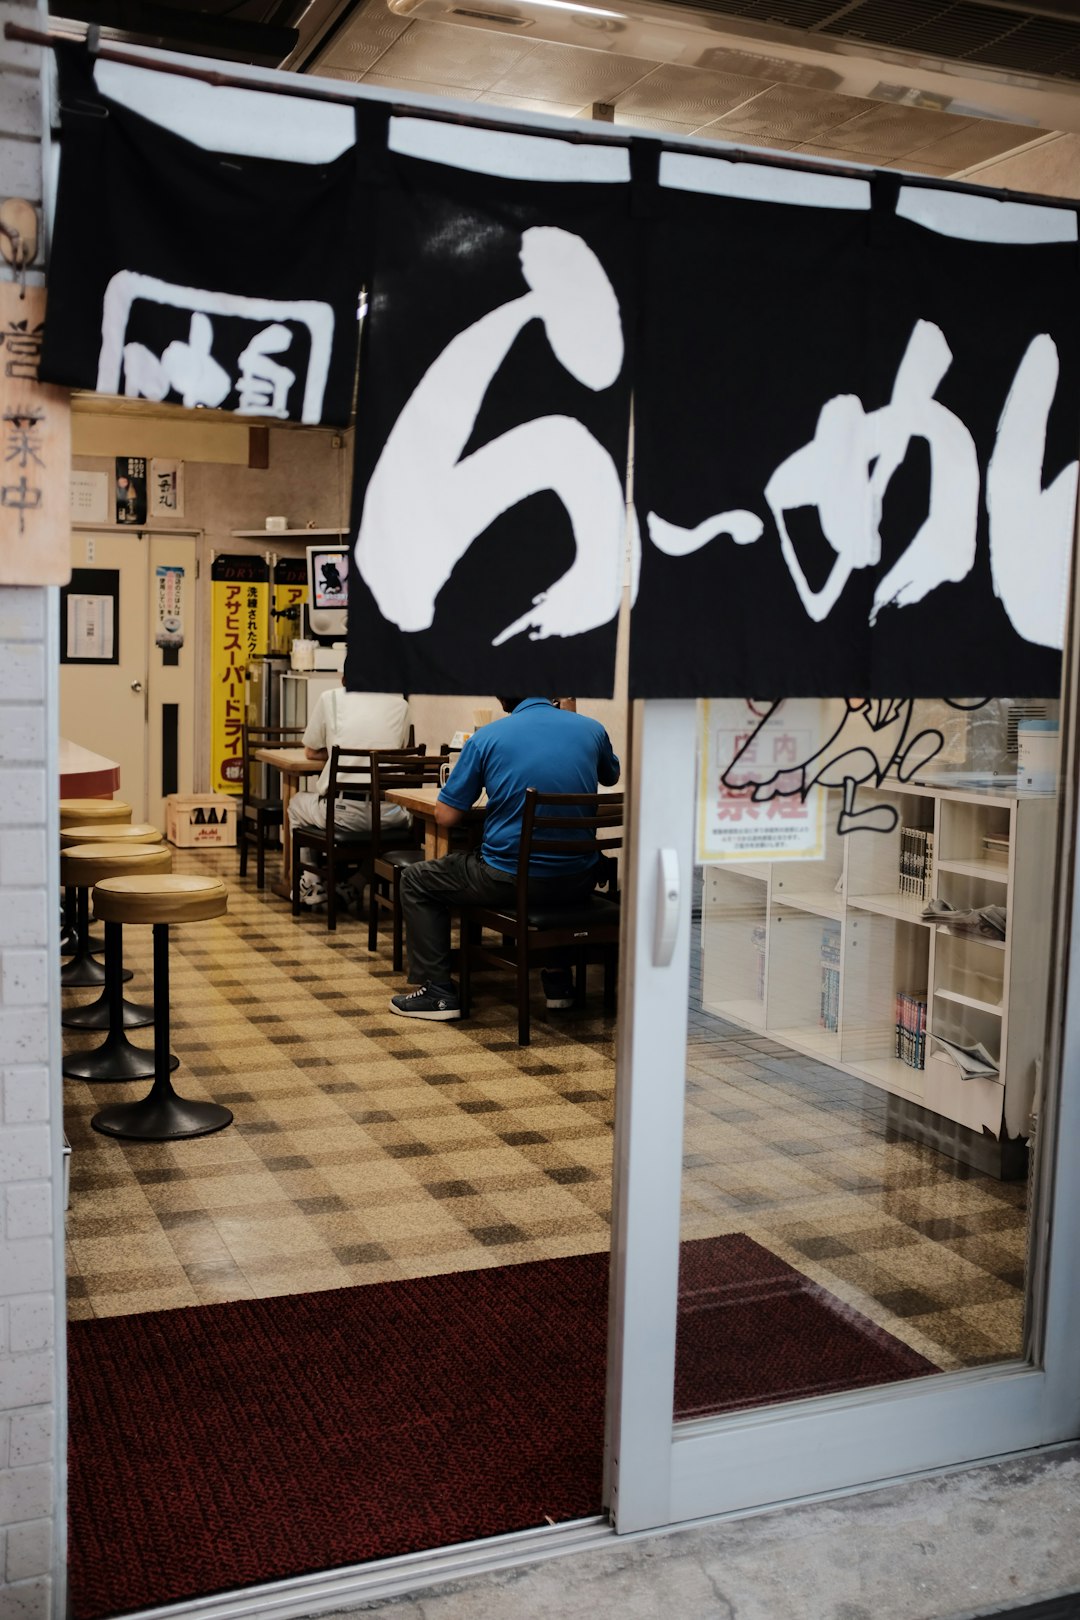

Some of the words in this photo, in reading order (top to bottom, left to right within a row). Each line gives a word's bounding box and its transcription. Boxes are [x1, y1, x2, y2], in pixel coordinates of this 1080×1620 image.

[0, 319, 47, 535] 営業中
[222, 585, 244, 755] アサヒスーパードライ
